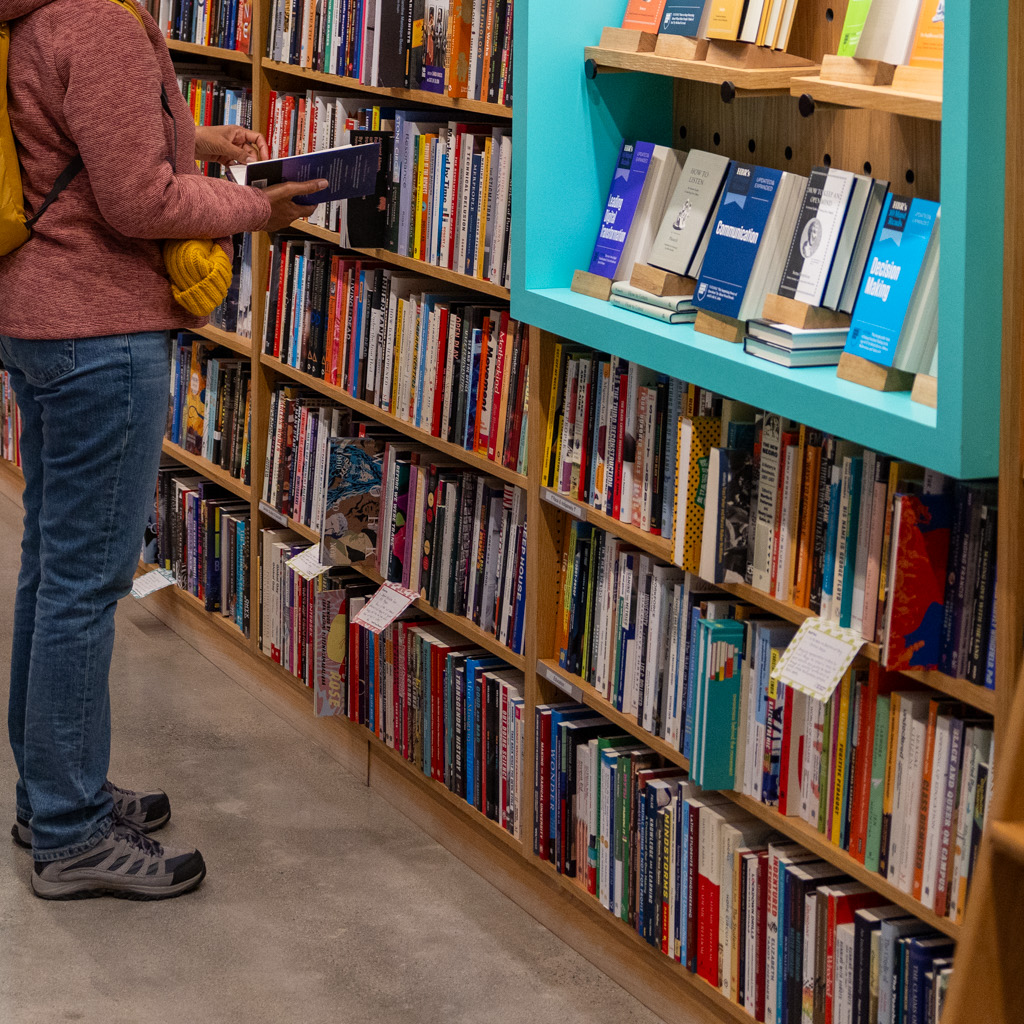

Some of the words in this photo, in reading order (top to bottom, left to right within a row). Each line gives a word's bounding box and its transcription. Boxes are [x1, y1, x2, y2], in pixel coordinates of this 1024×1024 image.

[444, 127, 453, 164] Marked
[688, 177, 705, 186] LISTEN
[690, 168, 702, 177] HOW
[702, 170, 710, 178] TO
[442, 179, 450, 203] Time
[607, 193, 624, 211] Leading
[603, 208, 618, 224] Digital
[599, 224, 626, 243] Transformation
[715, 220, 759, 244] Communication
[870, 256, 901, 281] Decision
[864, 276, 891, 302] Making
[481, 340, 492, 413] Movement
[494, 331, 505, 396] Motherkind
[606, 424, 617, 487] RECONSTRUCTION
[516, 559, 525, 602] HOUSE
[328, 671, 342, 708] ROSE
[949, 728, 960, 762] BLACK
[947, 765, 956, 786] AND
[943, 790, 954, 826] QUEER
[941, 828, 950, 844] ON
[662, 813, 670, 898] MINDSTORMS
[937, 846, 948, 892] CAMPUS
[771, 856, 779, 917] INDENTURED
